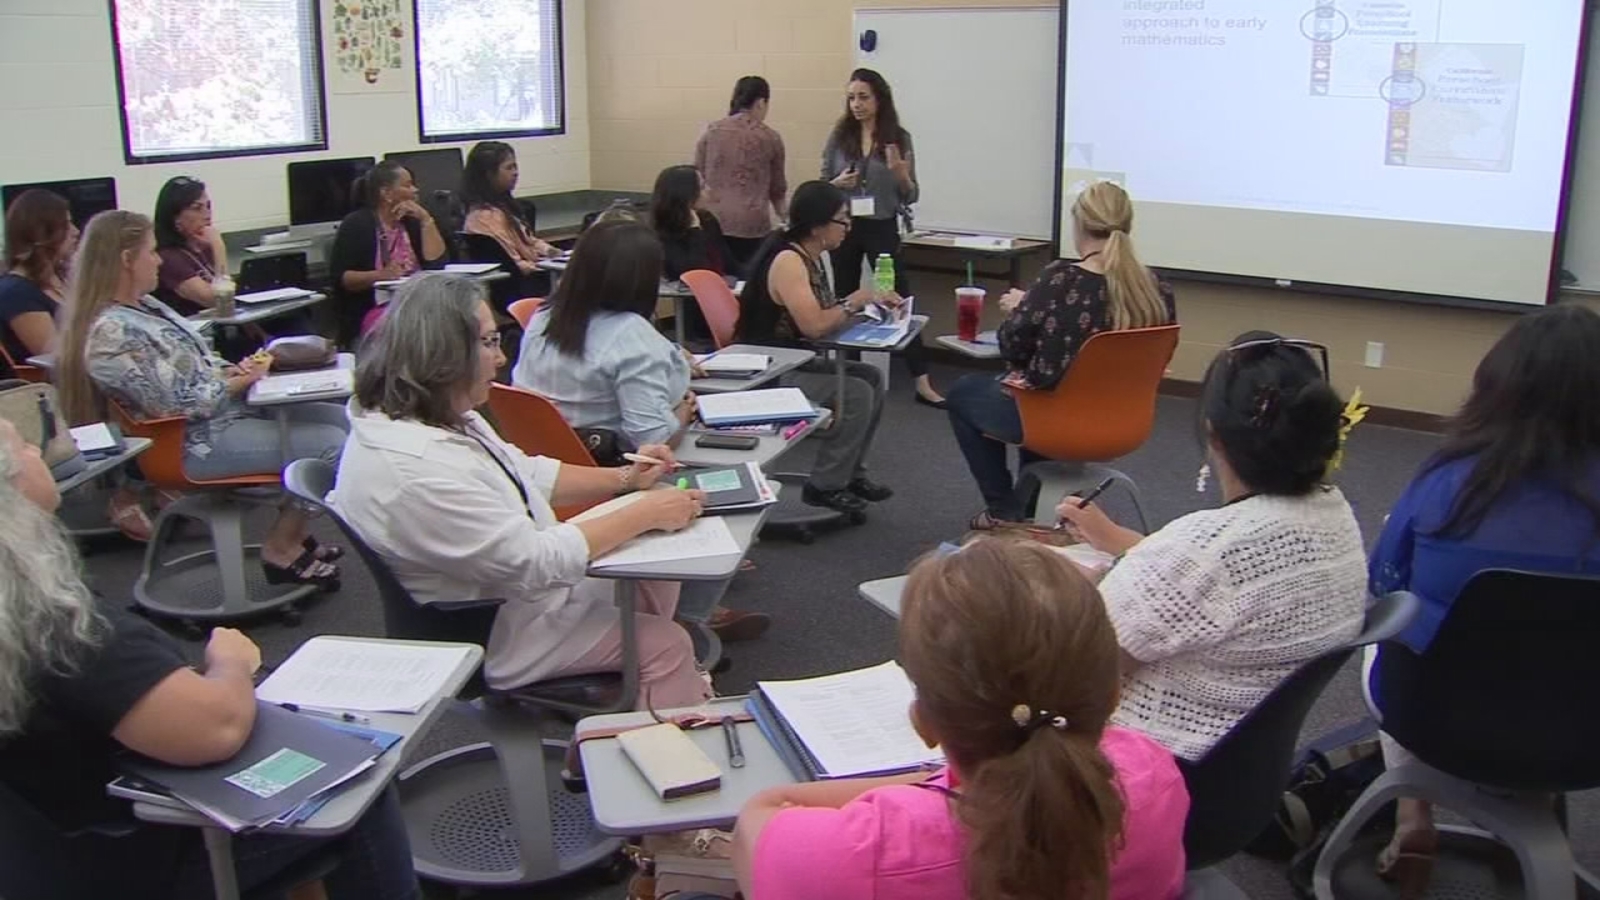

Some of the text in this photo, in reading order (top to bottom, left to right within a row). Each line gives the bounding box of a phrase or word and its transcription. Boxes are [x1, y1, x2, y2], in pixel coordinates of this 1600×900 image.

[1123, 0, 1205, 13] integrated
[1122, 16, 1267, 31] approach to early
[1121, 32, 1226, 46] mathematics
